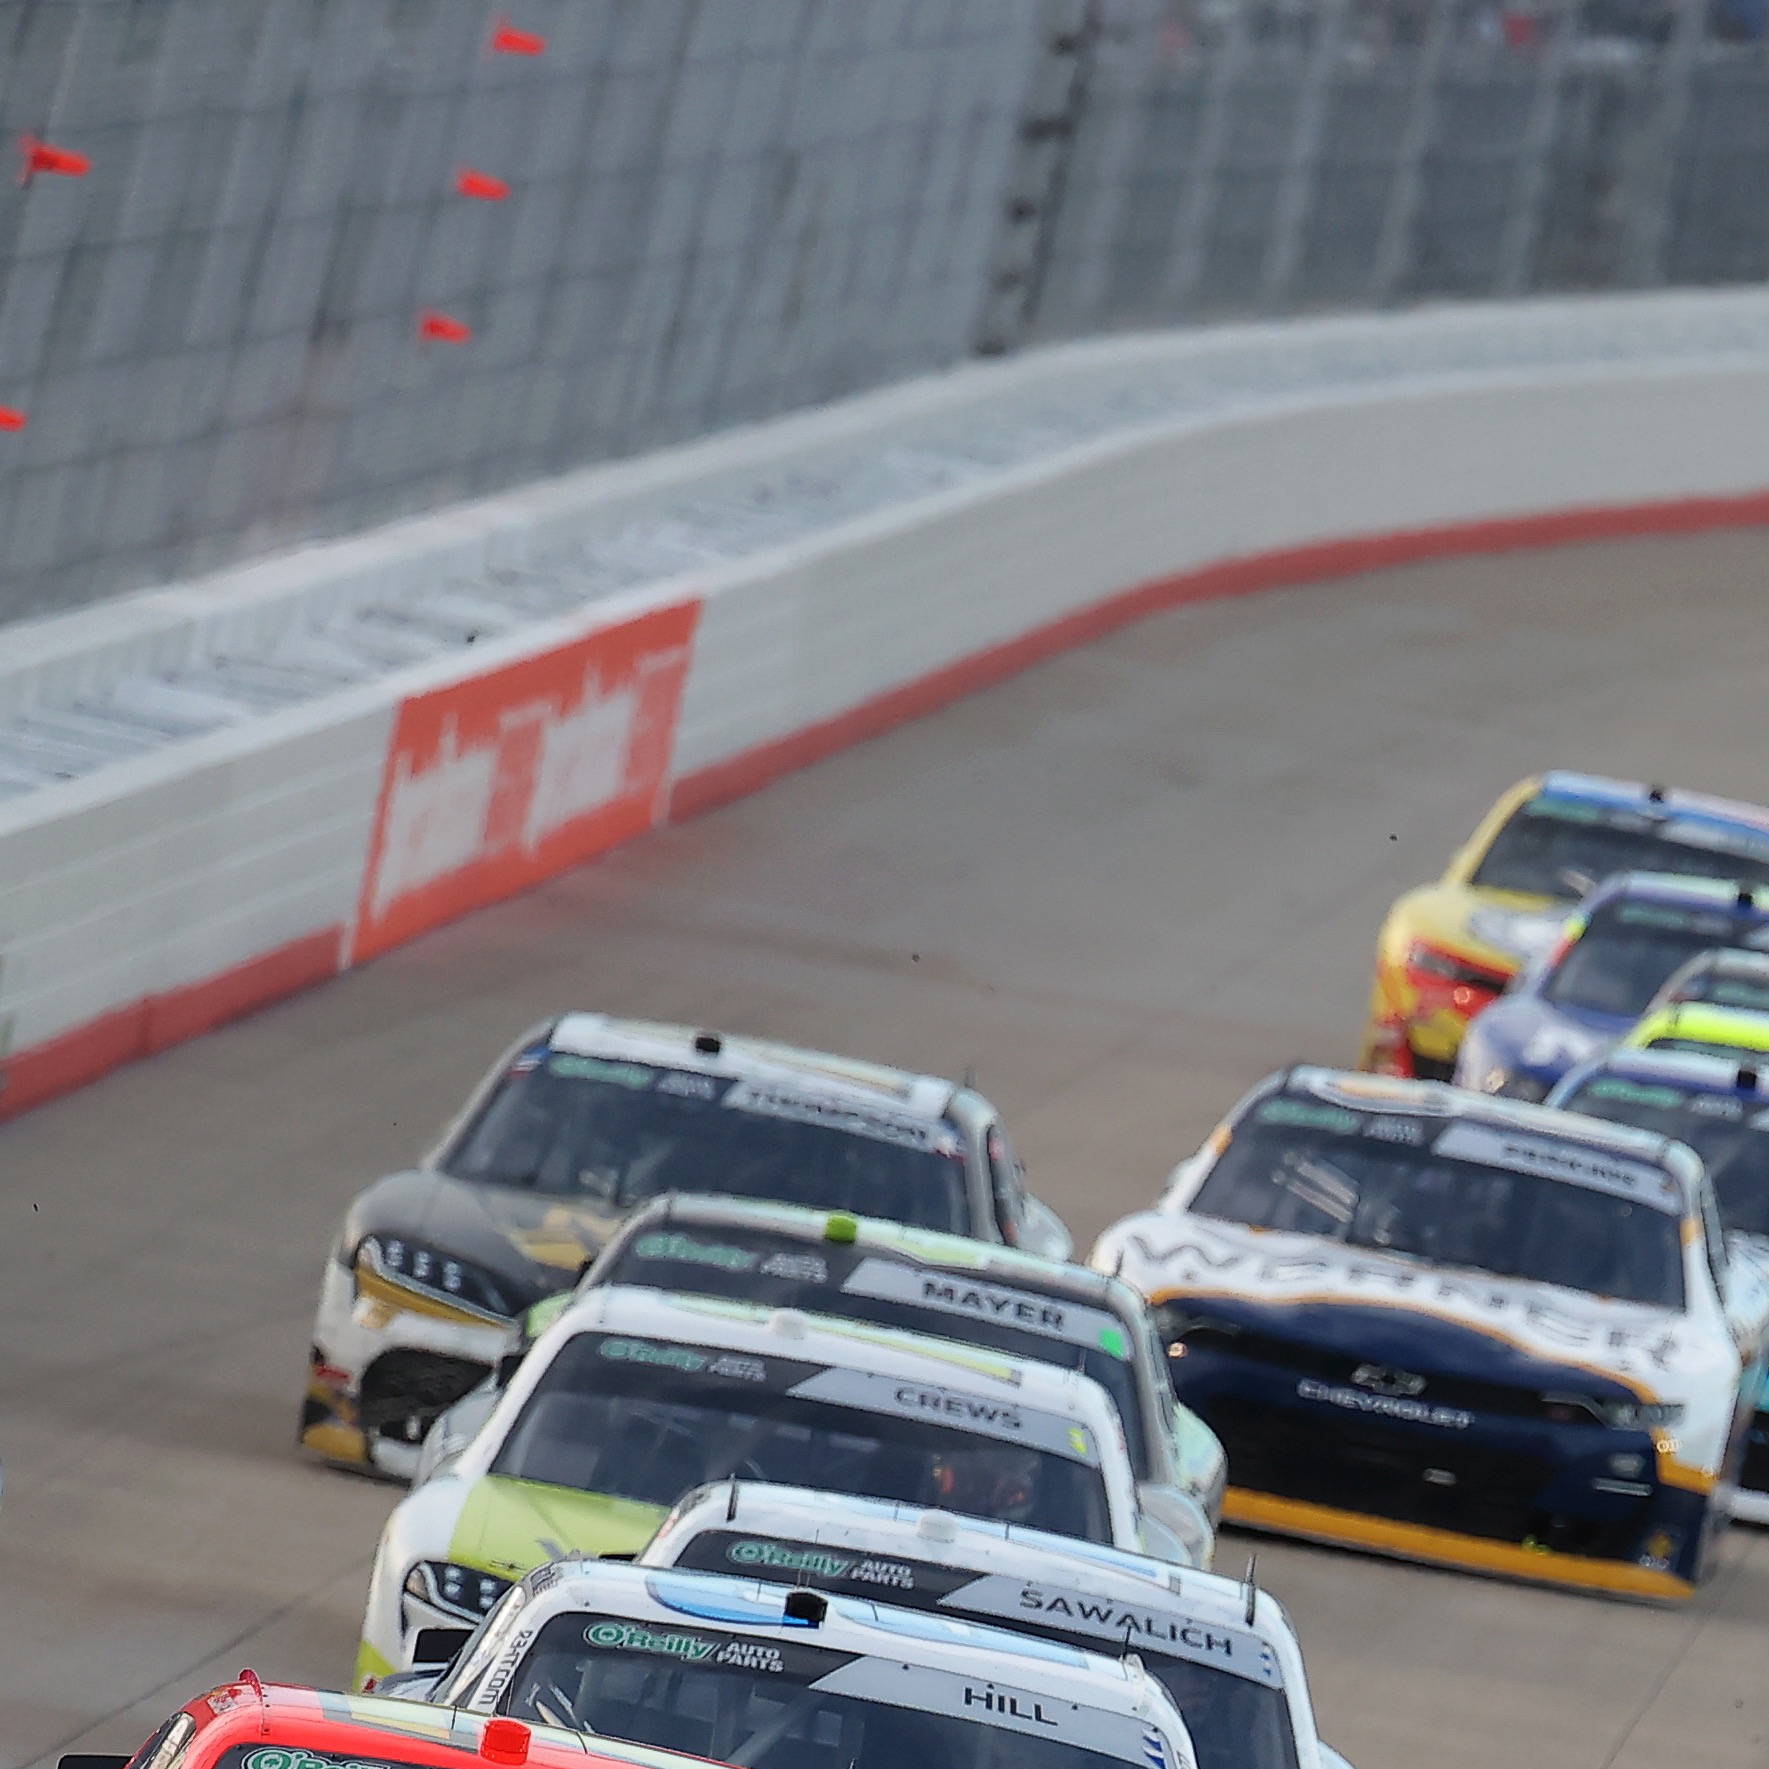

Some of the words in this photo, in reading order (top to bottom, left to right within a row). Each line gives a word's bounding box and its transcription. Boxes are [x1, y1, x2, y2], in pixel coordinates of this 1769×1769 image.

[920, 1279, 1066, 1333] MAYER
[1125, 1231, 1682, 1370] WERNER
[892, 1385, 1023, 1430] CREWS
[586, 1623, 712, 1662] O'Reilly
[726, 1640, 781, 1661] AUTO
[1018, 1587, 1234, 1657] SAWALICH
[716, 1651, 785, 1674] PARTS
[963, 1685, 1060, 1727] HILL
